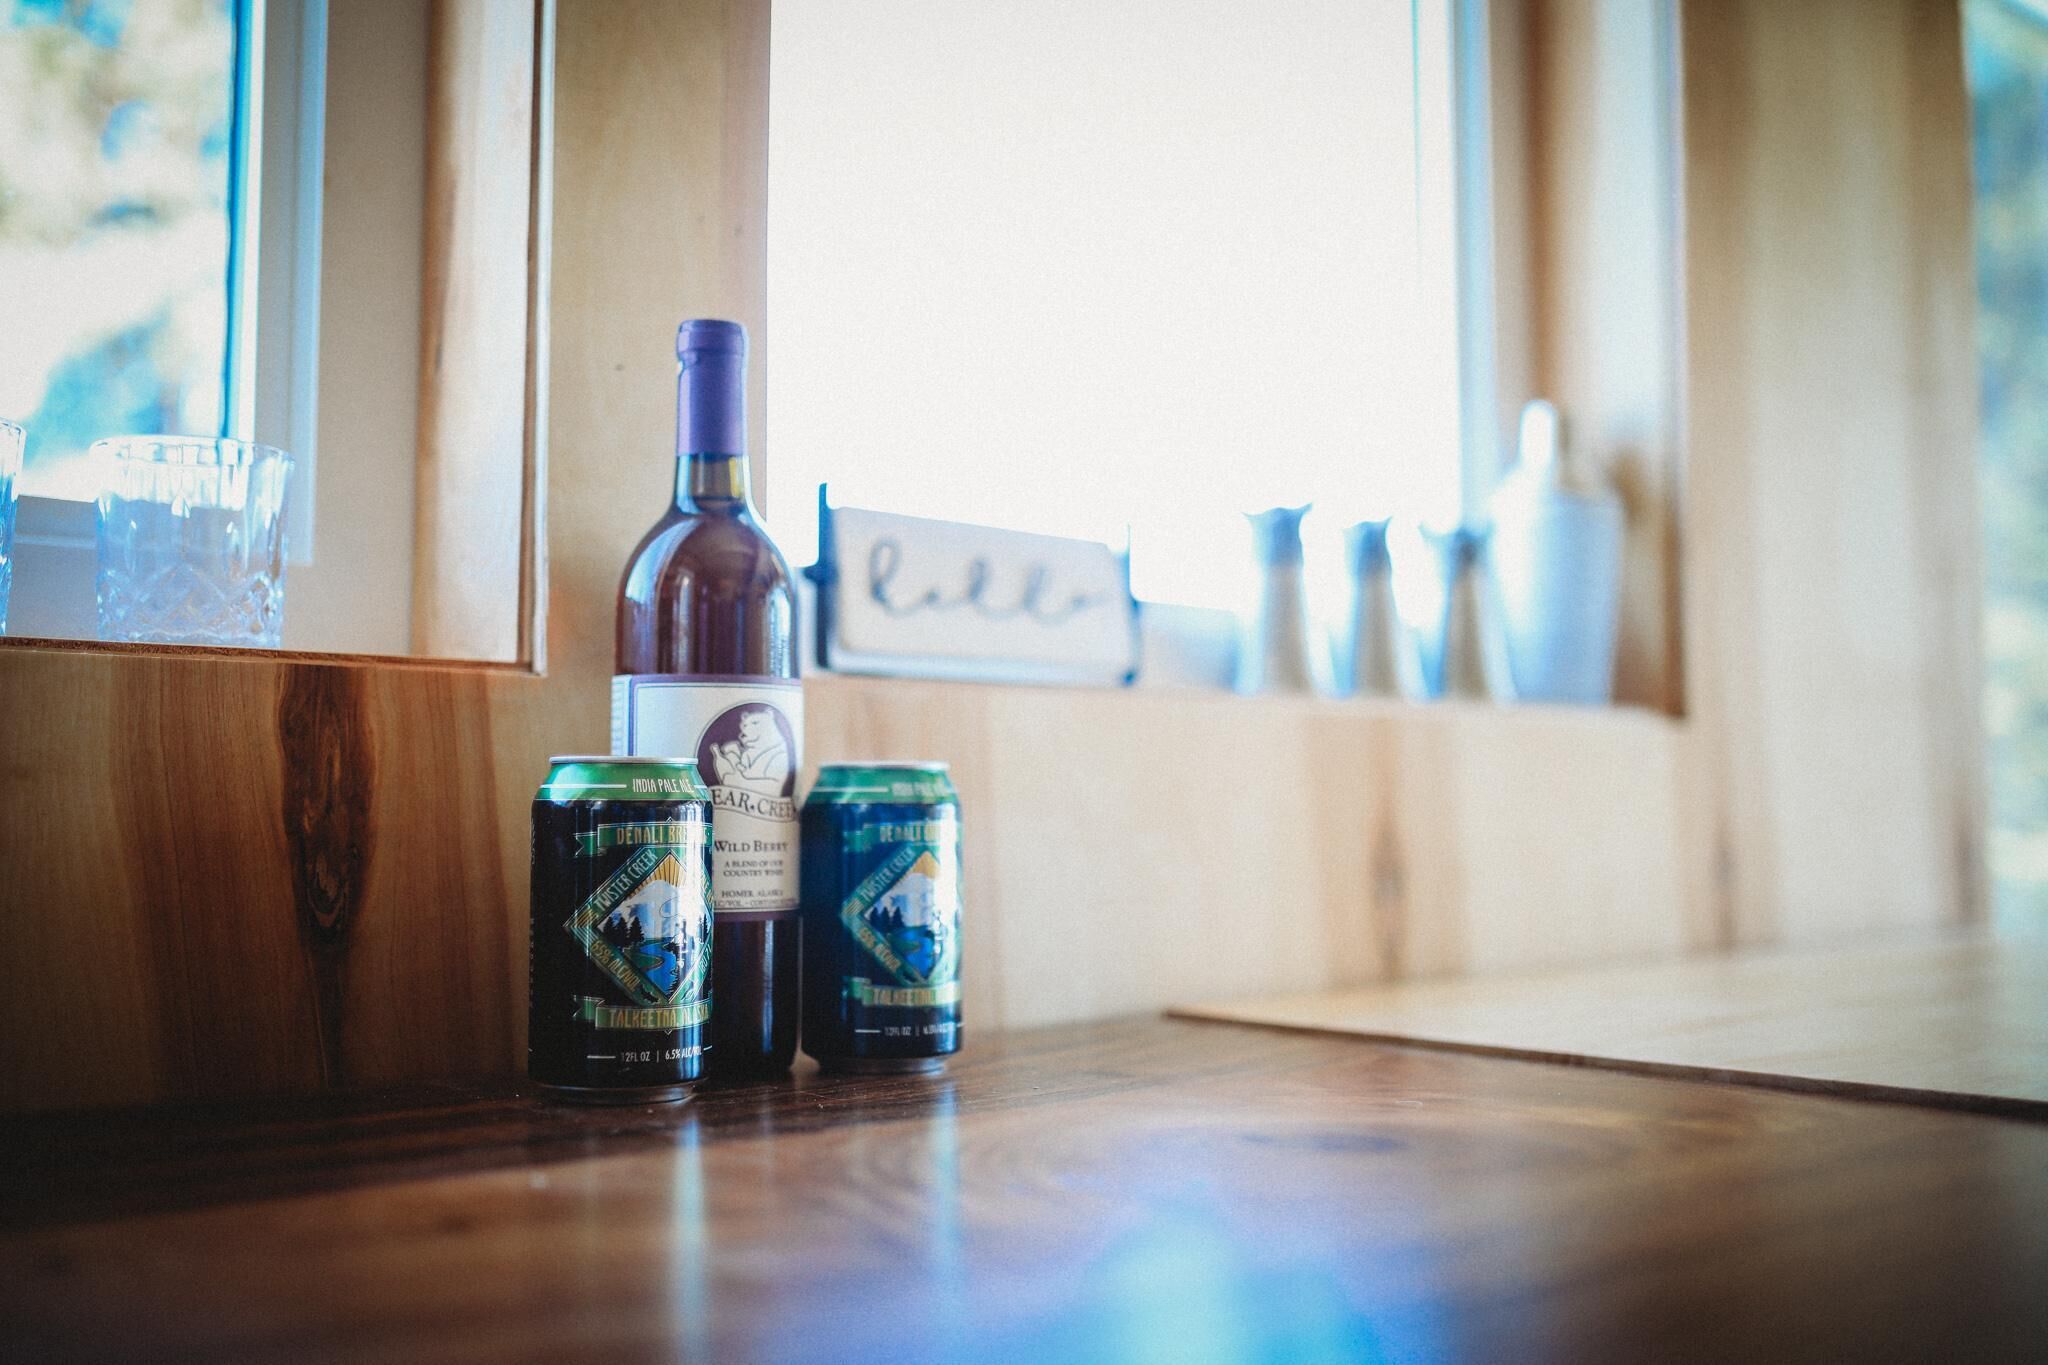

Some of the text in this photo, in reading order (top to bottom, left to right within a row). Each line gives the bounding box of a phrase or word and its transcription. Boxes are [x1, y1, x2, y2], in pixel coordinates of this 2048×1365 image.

[632, 778, 695, 793] INDIA PALE ALE
[711, 788, 750, 813] EAR
[616, 826, 663, 845] DENALI
[594, 849, 659, 912] TWISTER CREEK
[640, 1051, 651, 1062] OZ
[665, 1048, 681, 1060] 6.5%
